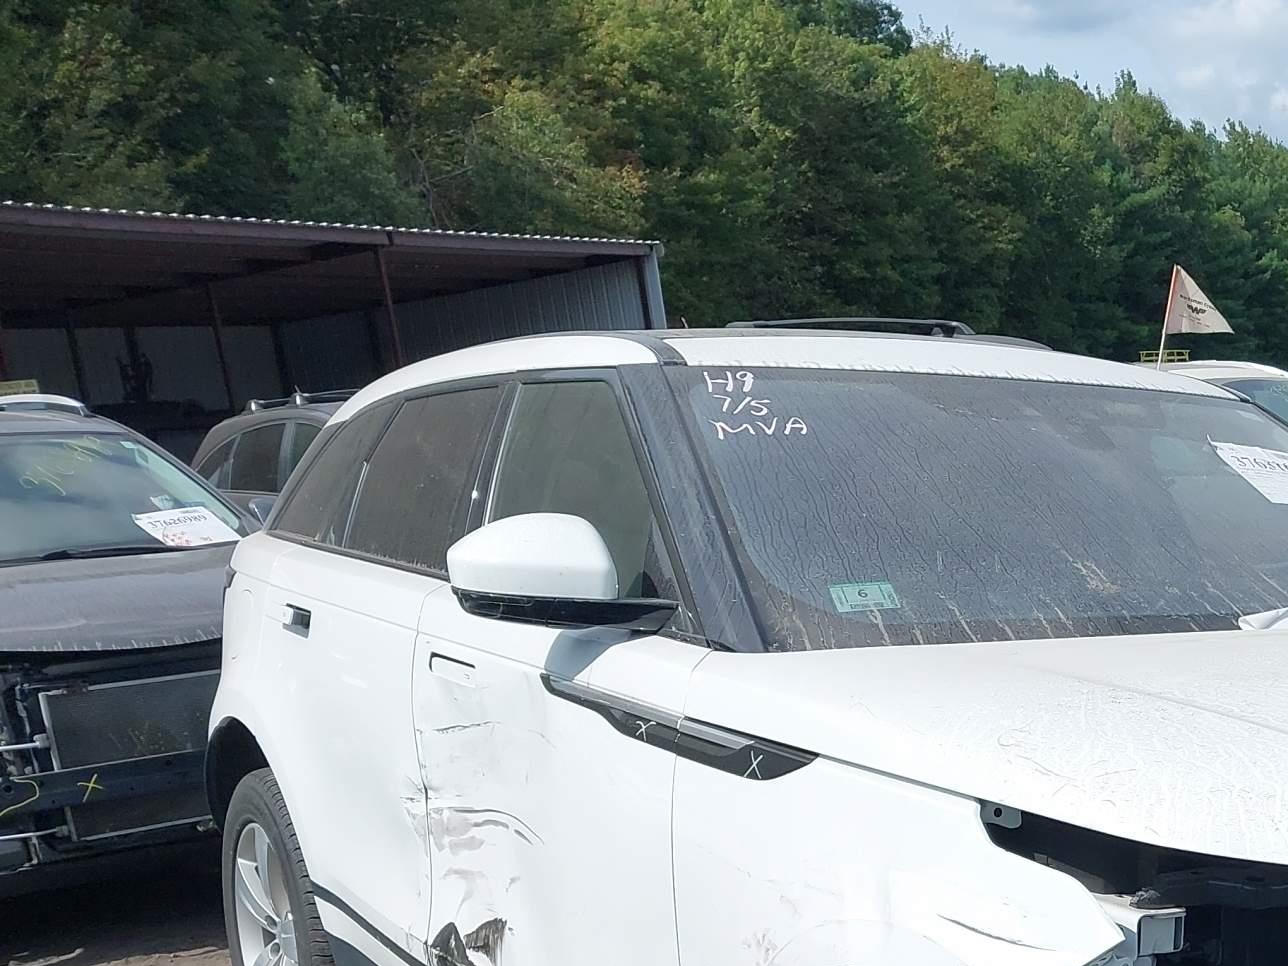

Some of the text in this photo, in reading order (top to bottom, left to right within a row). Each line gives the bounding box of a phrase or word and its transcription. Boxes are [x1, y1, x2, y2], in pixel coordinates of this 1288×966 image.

[703, 371, 754, 392] H9
[712, 395, 771, 416] 7/5
[708, 417, 808, 440] MVA
[857, 589, 869, 598] 6
